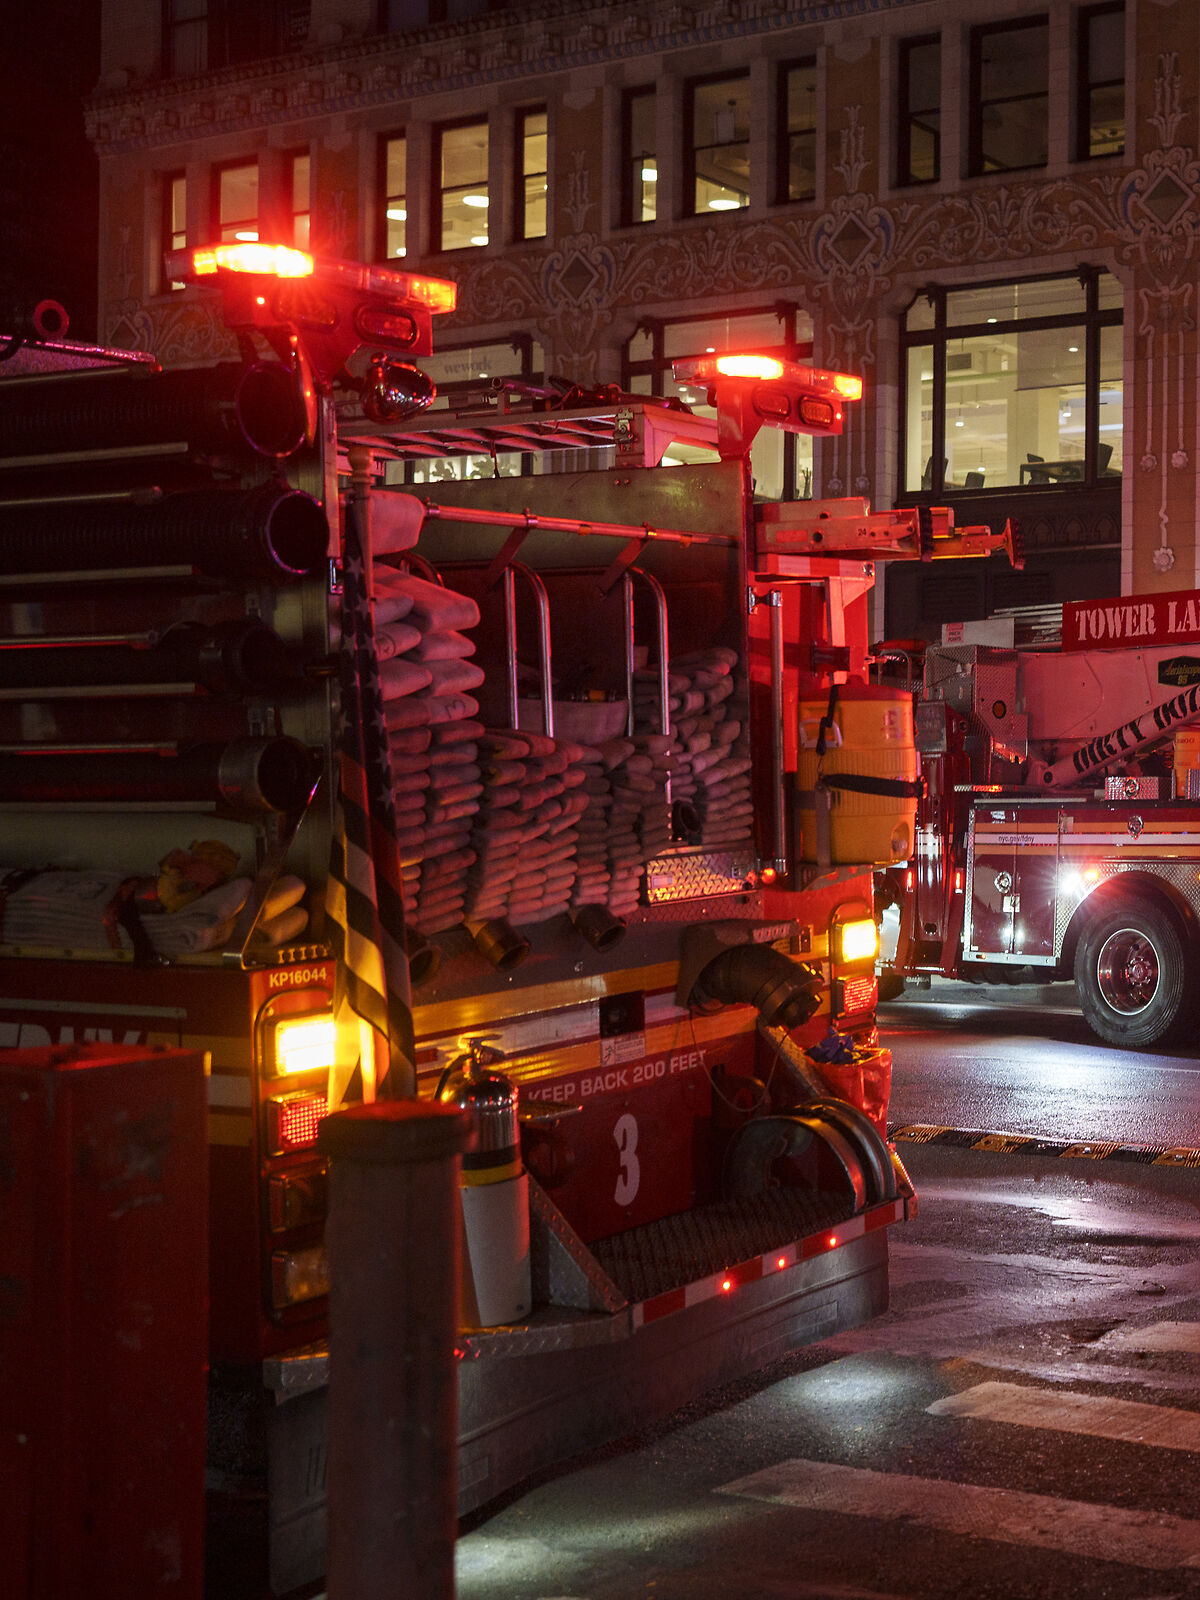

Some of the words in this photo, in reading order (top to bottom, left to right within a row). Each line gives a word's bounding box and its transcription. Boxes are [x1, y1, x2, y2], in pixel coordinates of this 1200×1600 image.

[1075, 603, 1157, 641] TOWER
[1073, 715, 1146, 774] DIRTY
[998, 834, 1035, 844] nyc.gov/fdny
[269, 967, 327, 988] KP16044
[528, 1083, 576, 1101] KEEP
[580, 1069, 629, 1097] BACK
[632, 1060, 666, 1084] 200
[669, 1050, 707, 1074] FEET
[613, 1113, 640, 1206] 3
